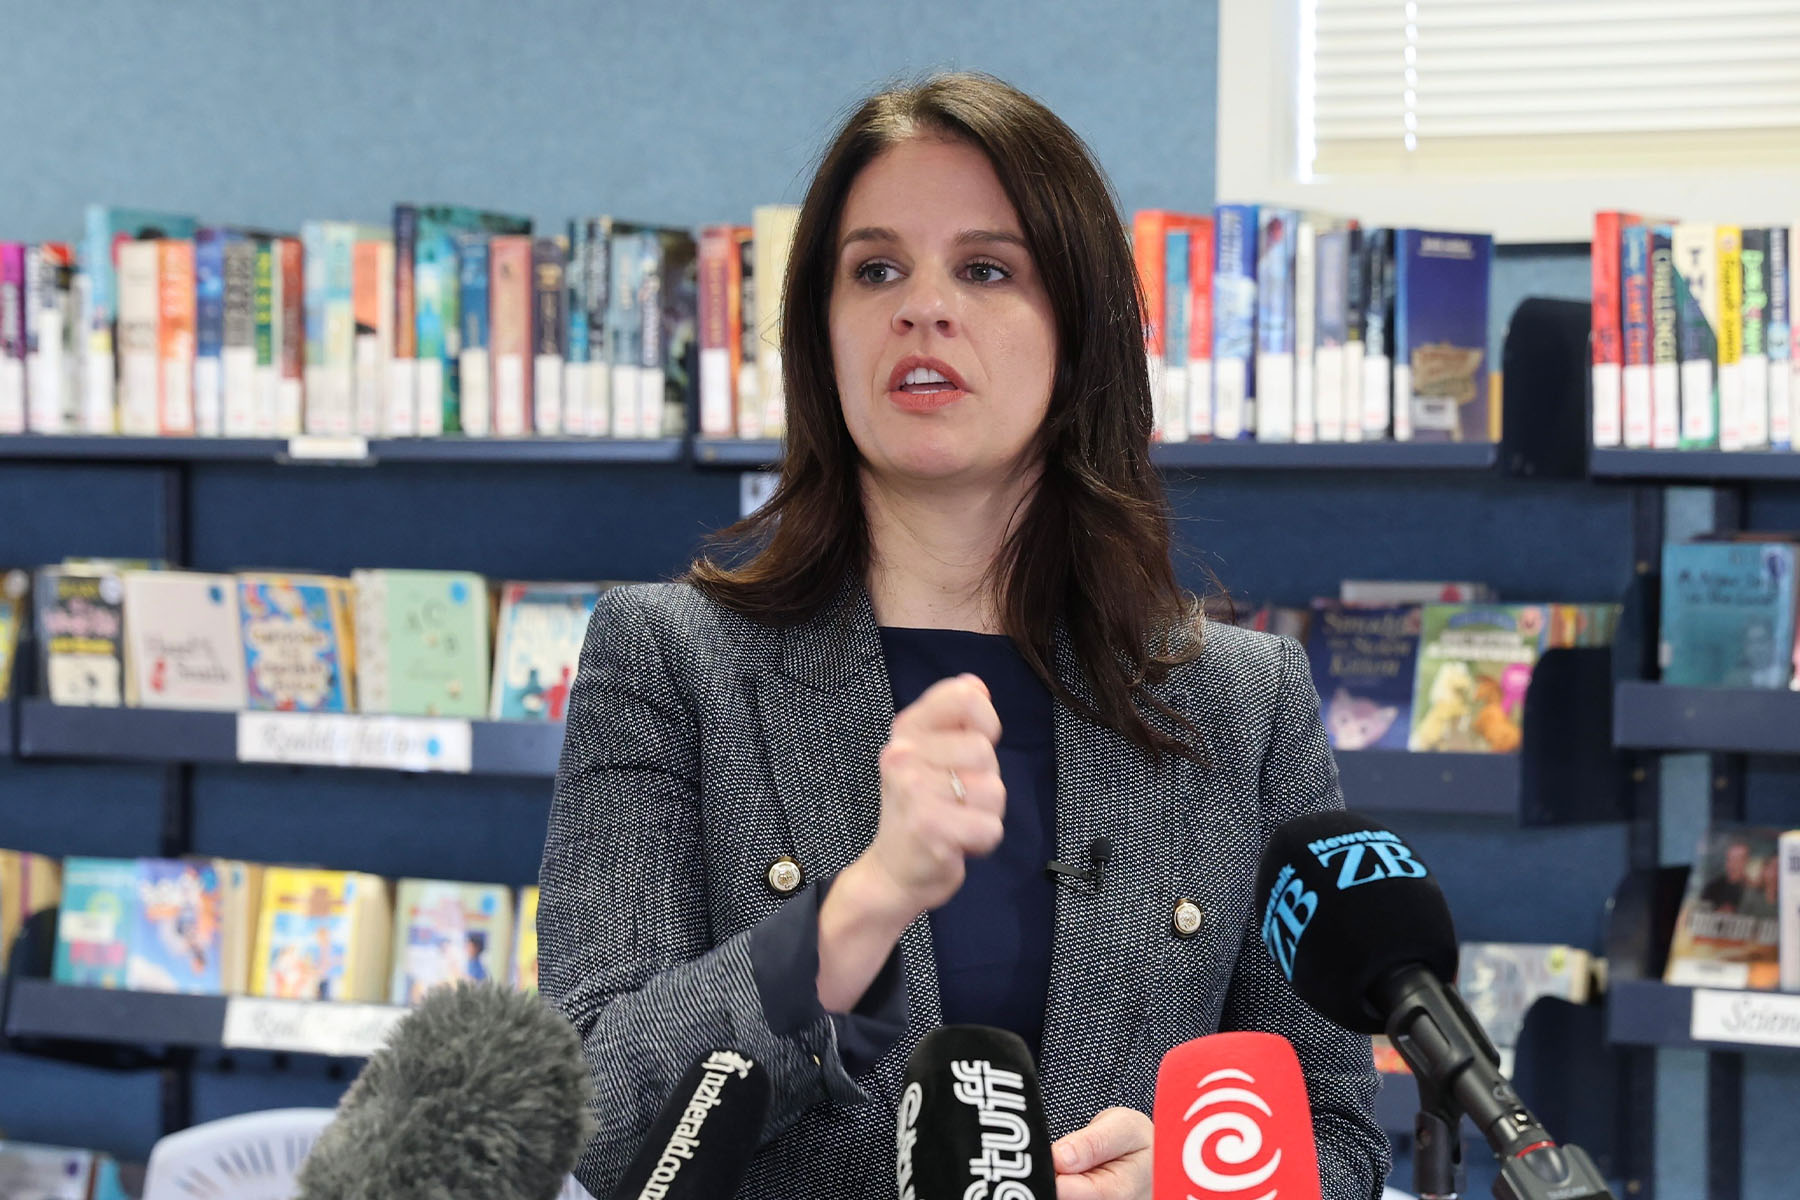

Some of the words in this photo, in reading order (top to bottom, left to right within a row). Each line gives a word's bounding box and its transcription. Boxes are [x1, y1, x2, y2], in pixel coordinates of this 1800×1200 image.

[1318, 842, 1427, 890] ZB
[1268, 878, 1319, 982] ZB
[637, 1071, 728, 1200] nzherald.co.n
